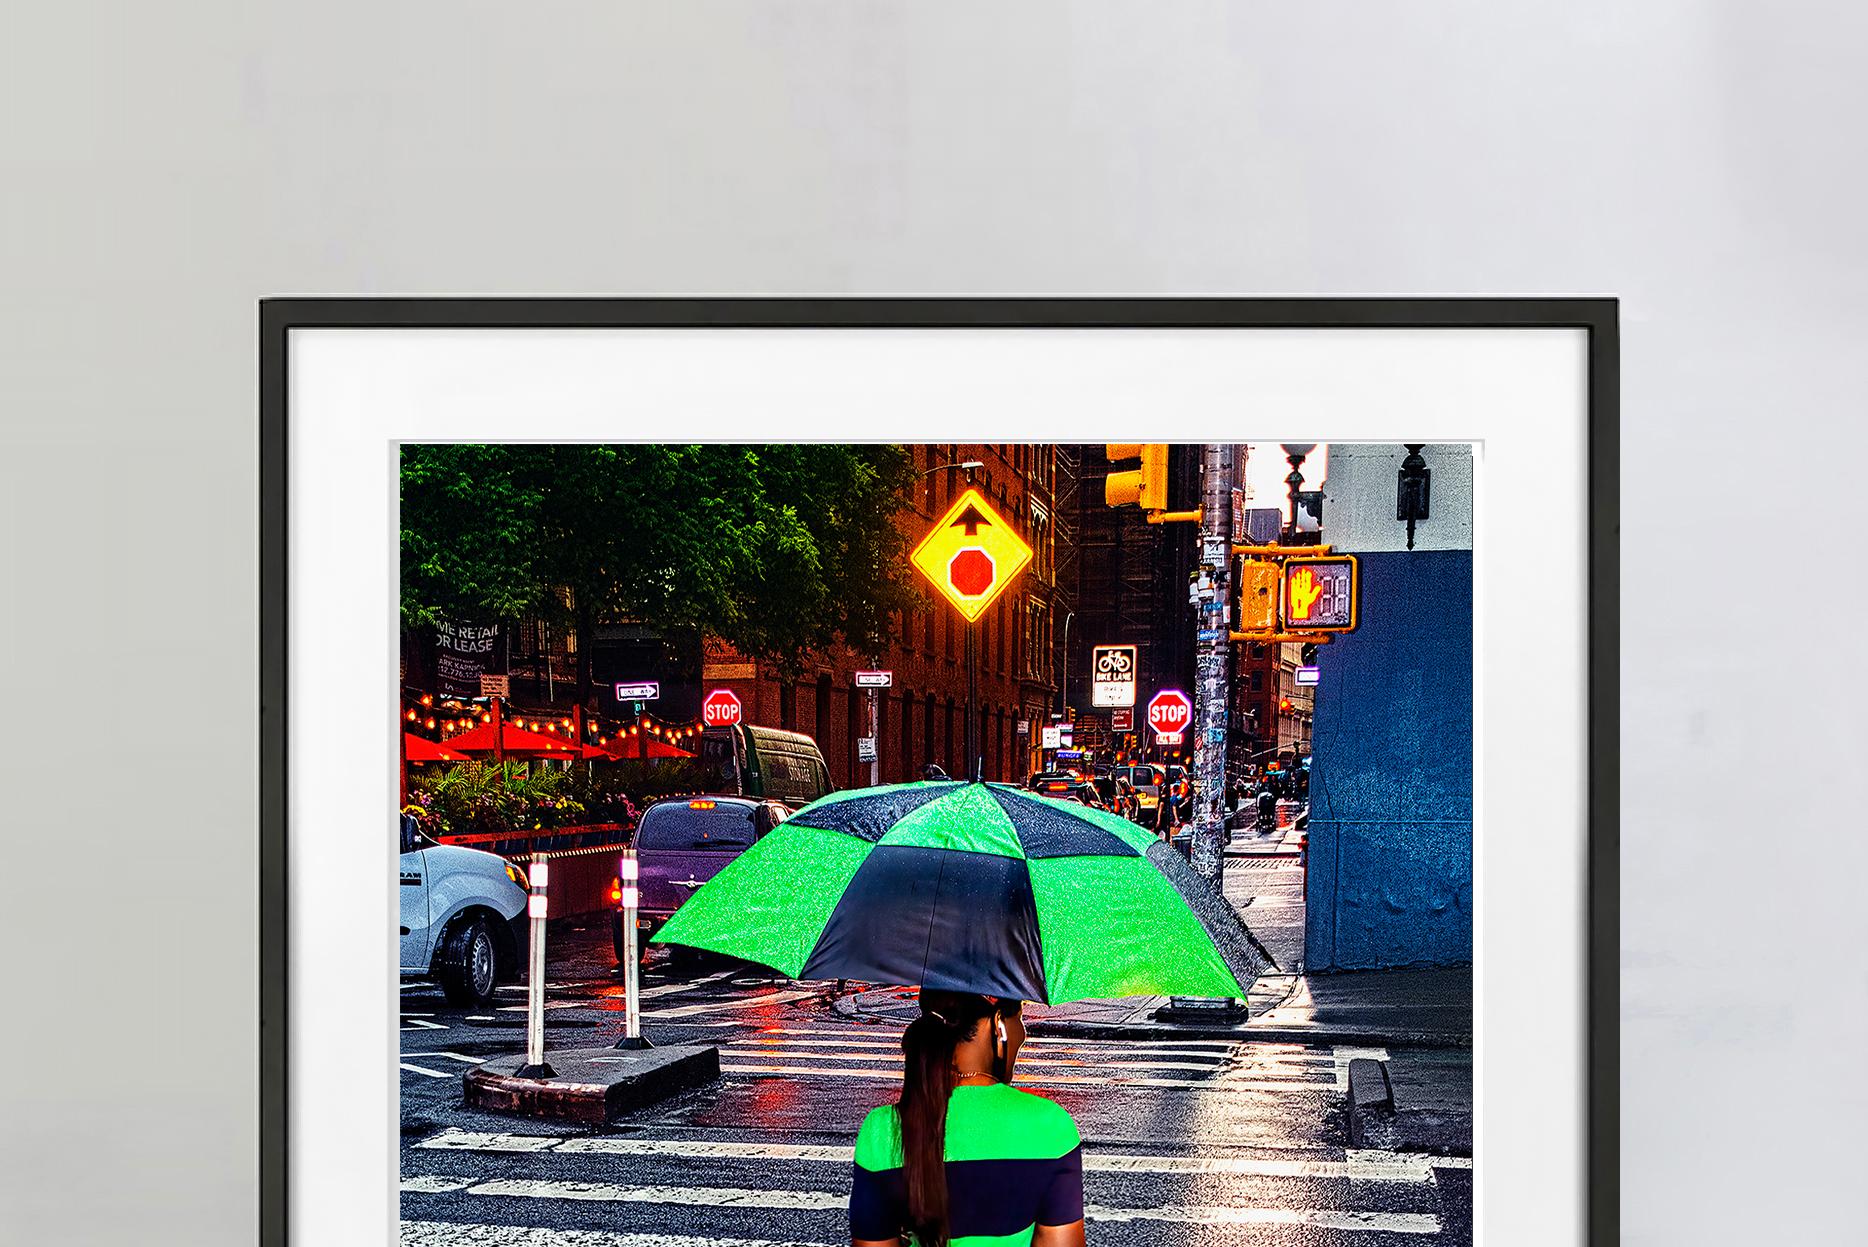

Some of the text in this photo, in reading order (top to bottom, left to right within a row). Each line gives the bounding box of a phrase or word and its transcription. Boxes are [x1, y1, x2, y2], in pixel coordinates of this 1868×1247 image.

[458, 624, 499, 640] RETAIL
[454, 638, 493, 653] LEASE
[1096, 672, 1132, 682] BIKE LANE
[707, 703, 739, 720] STOP
[1151, 704, 1187, 723] STOP
